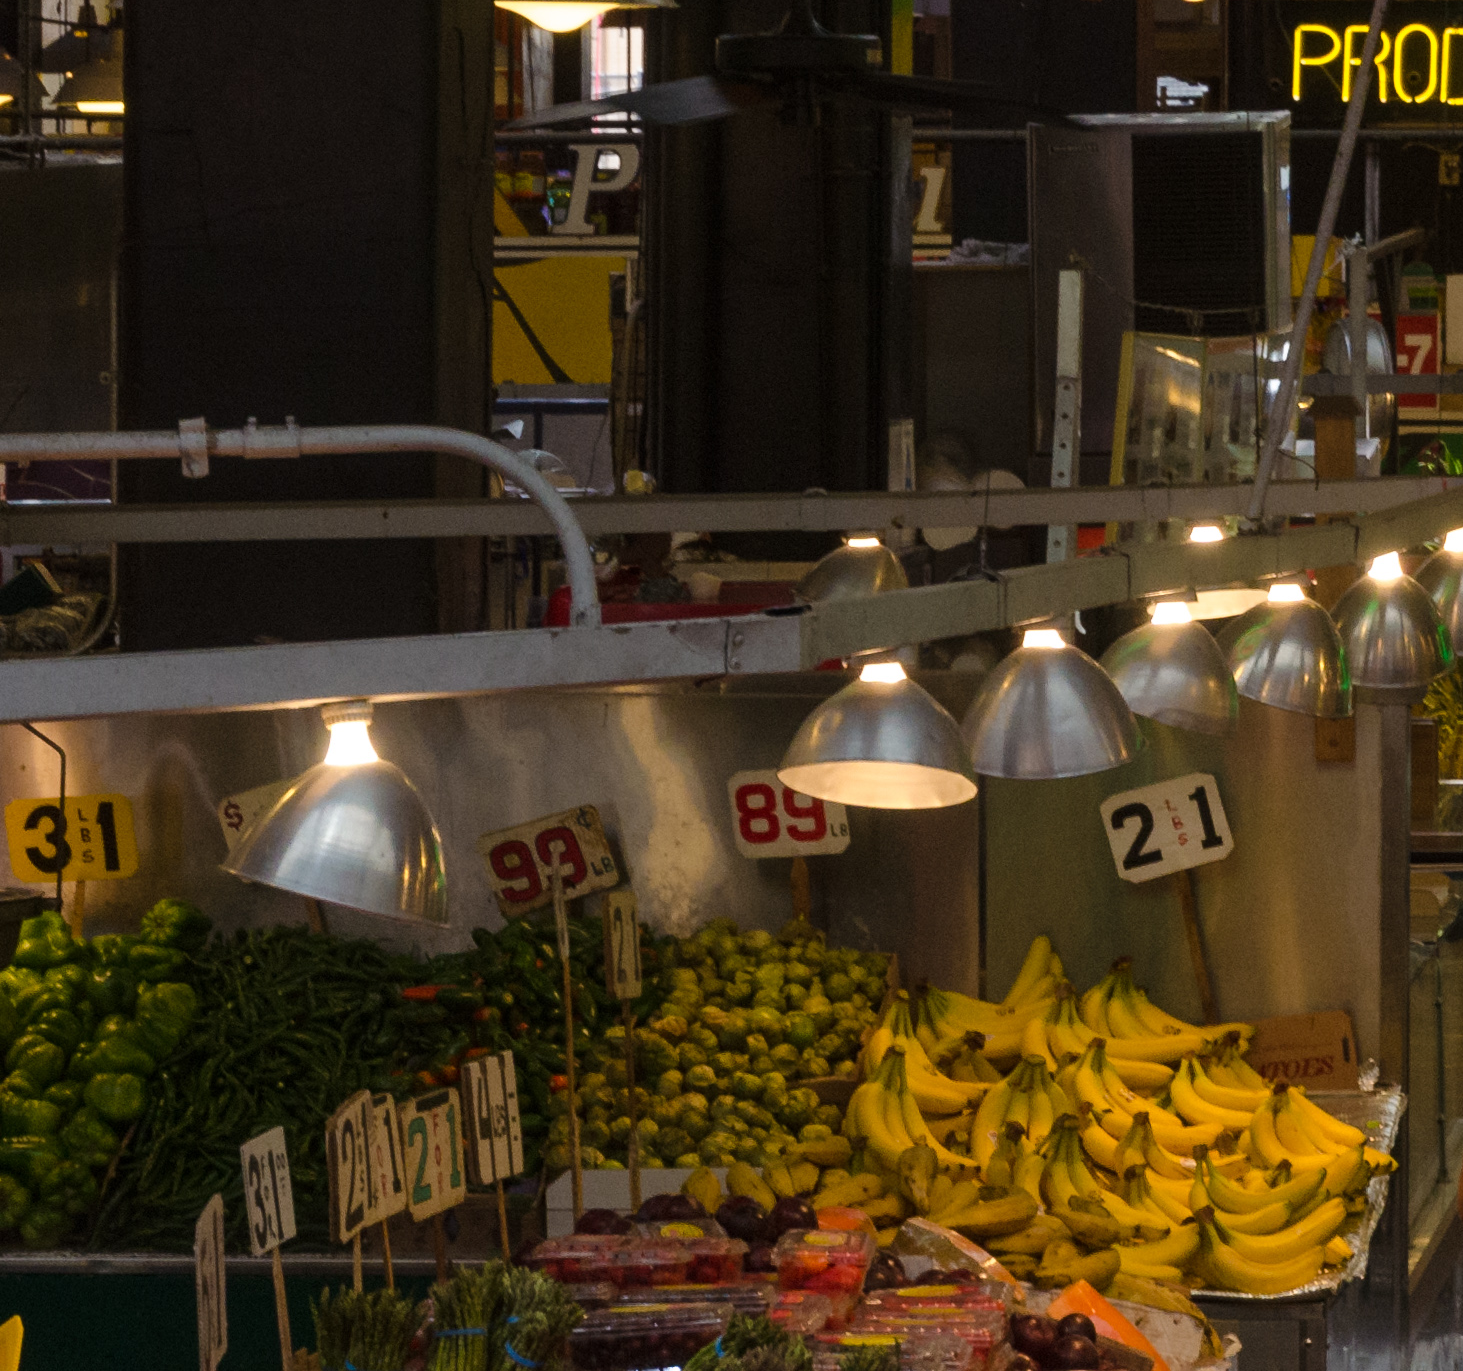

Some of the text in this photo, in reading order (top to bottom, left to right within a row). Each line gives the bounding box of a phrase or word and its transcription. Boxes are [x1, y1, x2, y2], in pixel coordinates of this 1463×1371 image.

[24, 804, 71, 874] 3
[95, 800, 121, 872] 1
[734, 782, 827, 845] 89
[1110, 801, 1163, 872] 2
[1188, 785, 1224, 851] 1
[407, 1116, 431, 1204] 2
